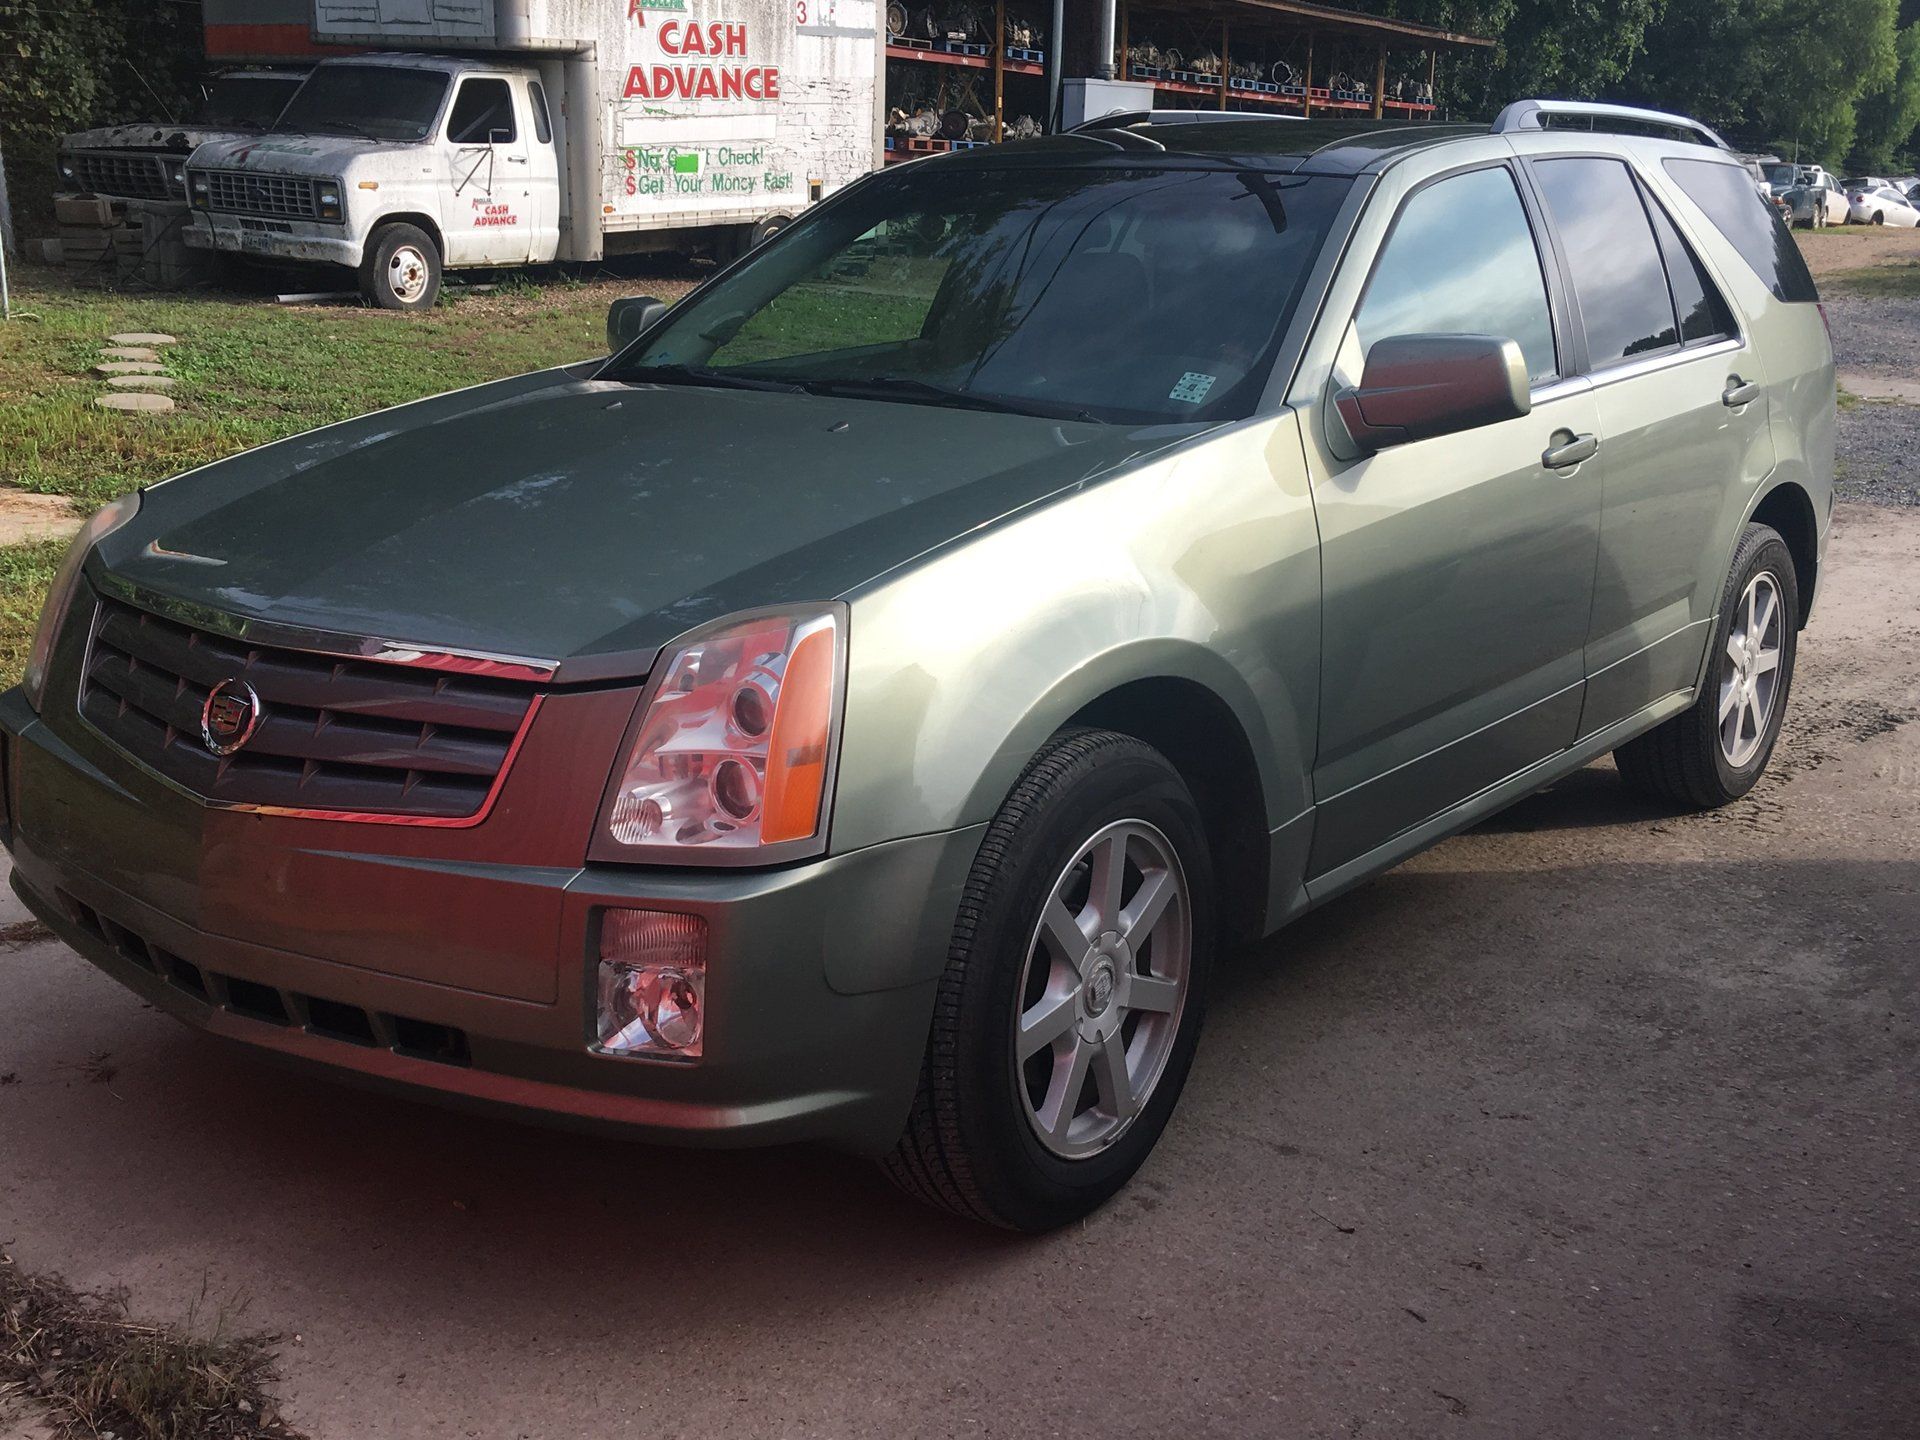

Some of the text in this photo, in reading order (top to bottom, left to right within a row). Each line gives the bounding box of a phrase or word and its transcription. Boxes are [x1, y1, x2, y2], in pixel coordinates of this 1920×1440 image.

[658, 20, 747, 57] CASH
[622, 63, 781, 101] ADVANCE
[718, 146, 763, 167] Check!
[639, 175, 664, 194] Get
[674, 174, 704, 193] Your
[485, 205, 509, 215] CASH
[474, 215, 517, 226] ADVANCE
